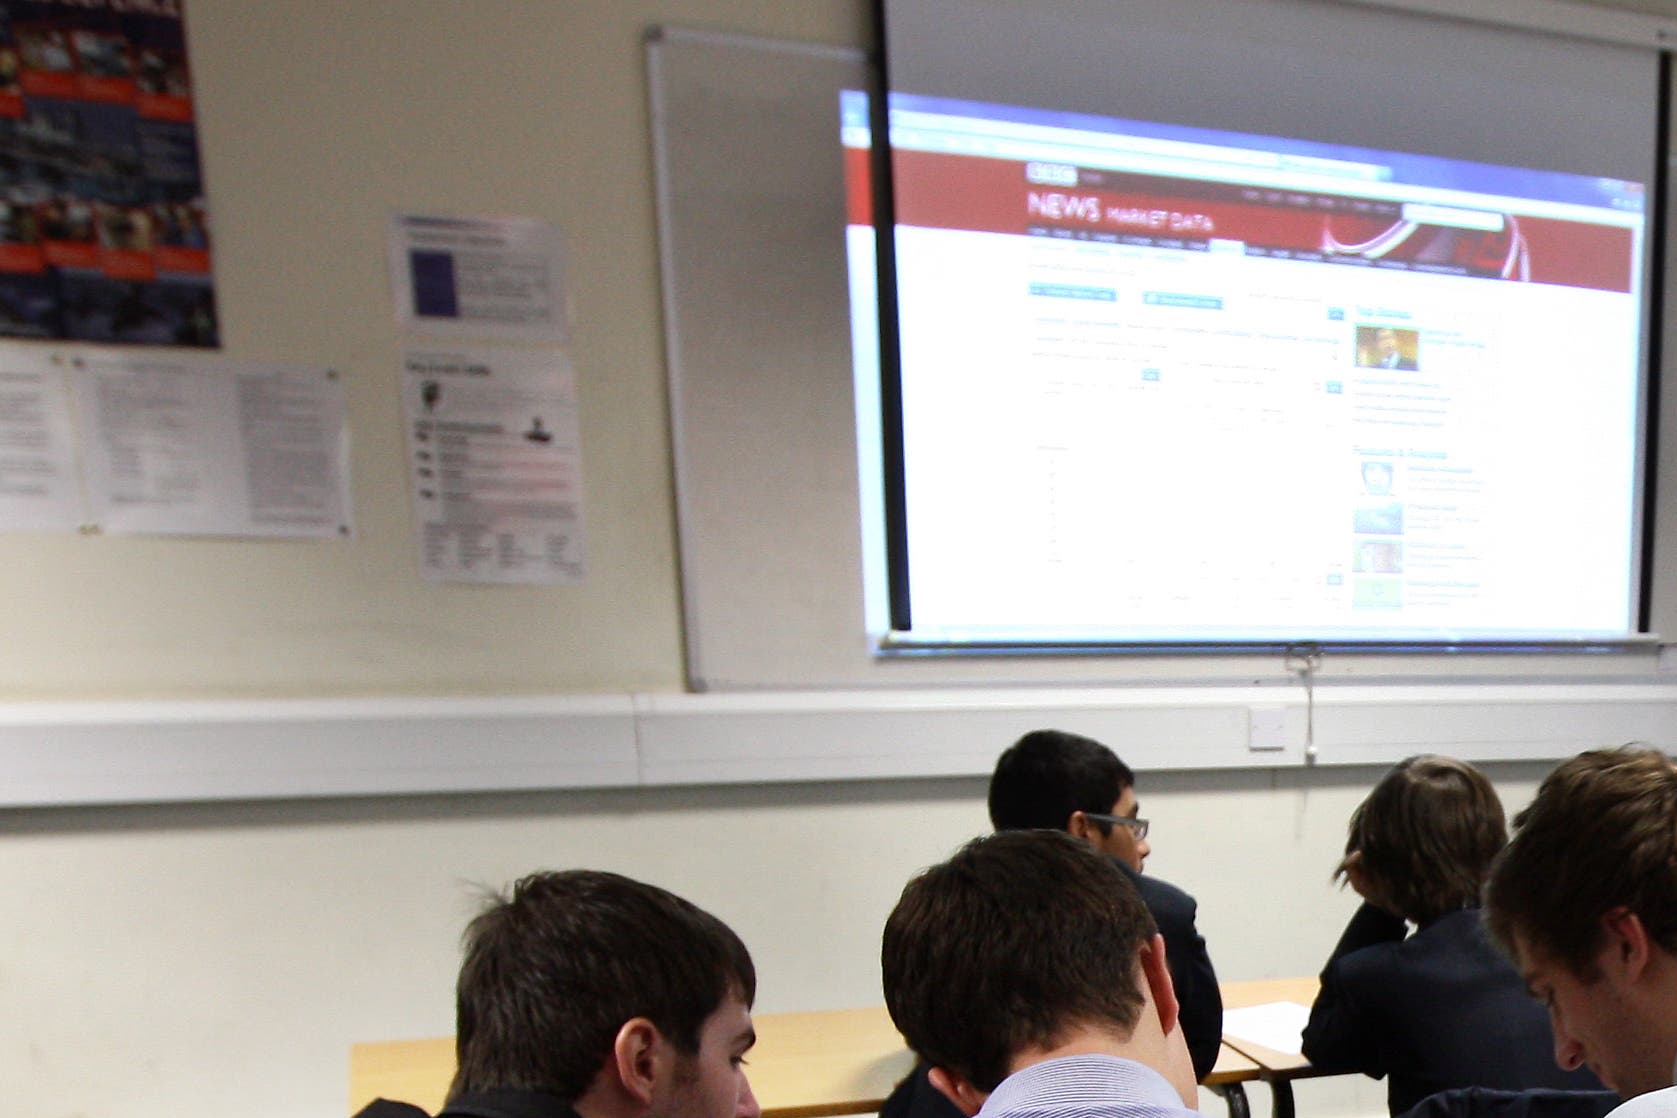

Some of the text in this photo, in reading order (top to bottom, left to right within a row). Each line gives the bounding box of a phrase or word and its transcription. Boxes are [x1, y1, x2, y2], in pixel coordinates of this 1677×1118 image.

[1028, 192, 1214, 231] NEWS MARKET DATA
